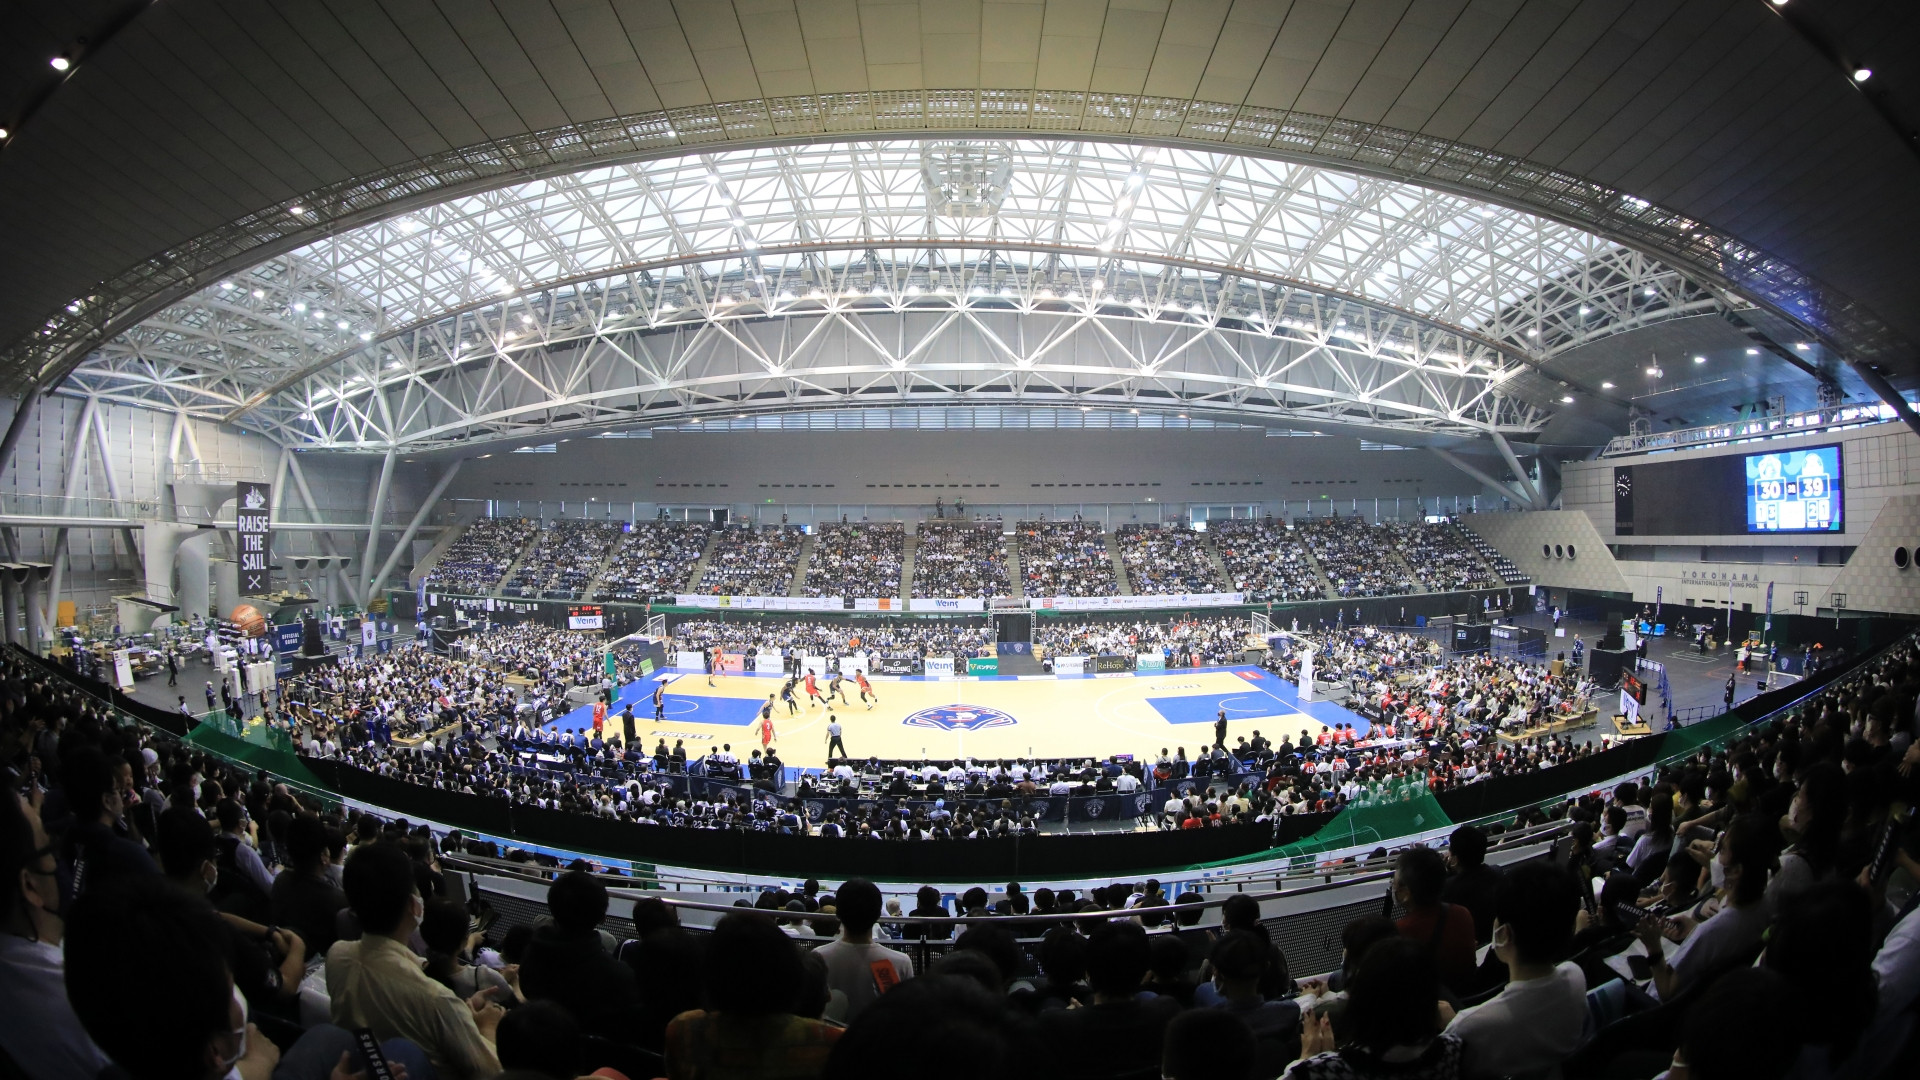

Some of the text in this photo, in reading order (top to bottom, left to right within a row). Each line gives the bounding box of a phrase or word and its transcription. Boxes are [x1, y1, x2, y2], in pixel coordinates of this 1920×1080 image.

[1761, 481, 1781, 499] 30
[1803, 478, 1824, 497] 39
[238, 516, 268, 532] RAISE
[244, 534, 264, 551] THE
[242, 554, 266, 570] SAIL
[1682, 571, 1758, 581] YOKOHAMA
[1682, 579, 1718, 587] INTERNATIONAL
[936, 600, 958, 608] Weins
[575, 618, 596, 626] Weins
[926, 662, 953, 672] Weins
[674, 817, 684, 826] 23
